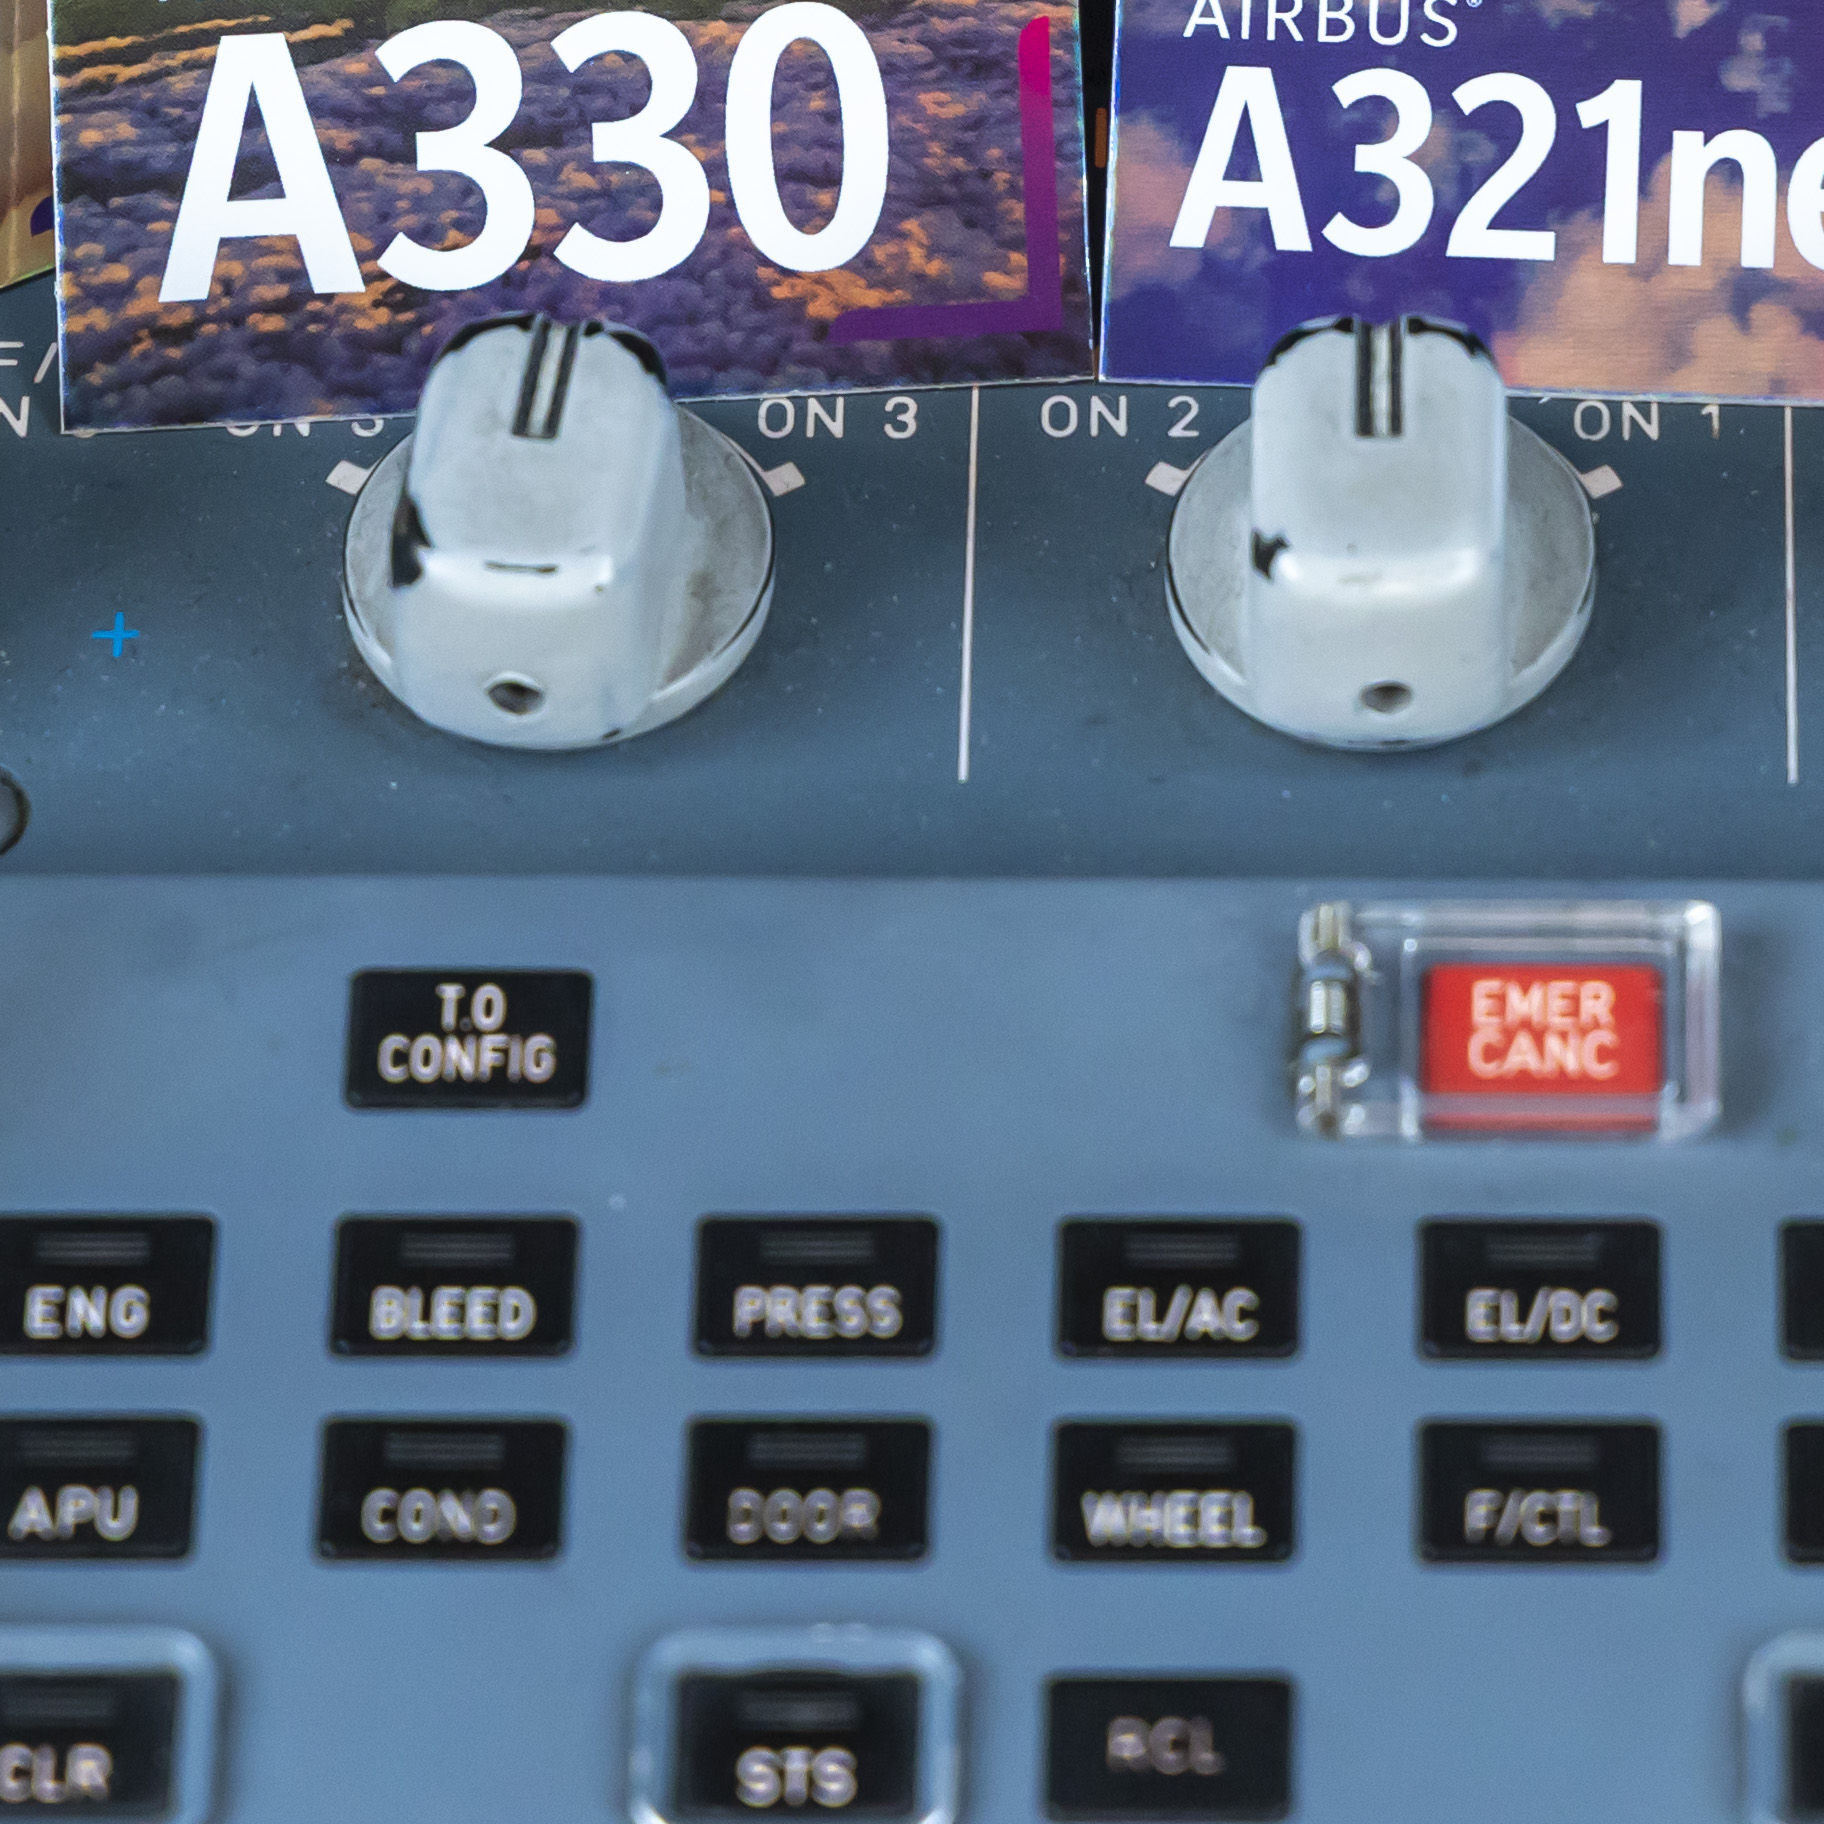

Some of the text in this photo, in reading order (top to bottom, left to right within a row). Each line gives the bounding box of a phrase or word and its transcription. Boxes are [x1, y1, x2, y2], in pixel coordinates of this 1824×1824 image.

[158, 0, 890, 303] A330
[757, 397, 919, 440] ON 3
[1038, 397, 1201, 439] ON 2
[1574, 399, 1720, 441] ON 1
[1470, 979, 1617, 1028] EMER
[376, 1034, 556, 1083] CONFIG
[1467, 1027, 1619, 1080] CANC
[23, 1285, 150, 1339] ENG
[369, 1285, 537, 1341] BLEED
[732, 1285, 904, 1339] PRESS
[1102, 1286, 1259, 1343] EL/AC
[1465, 1287, 1619, 1344] EL/DC
[6, 1485, 139, 1543] APU
[360, 1487, 517, 1546] COND
[726, 1488, 882, 1545] DOOR
[1081, 1491, 1267, 1548] WHEEL
[1463, 1491, 1612, 1548] F/CTL
[1105, 1715, 1226, 1775] RCL
[734, 1746, 859, 1809] STS
